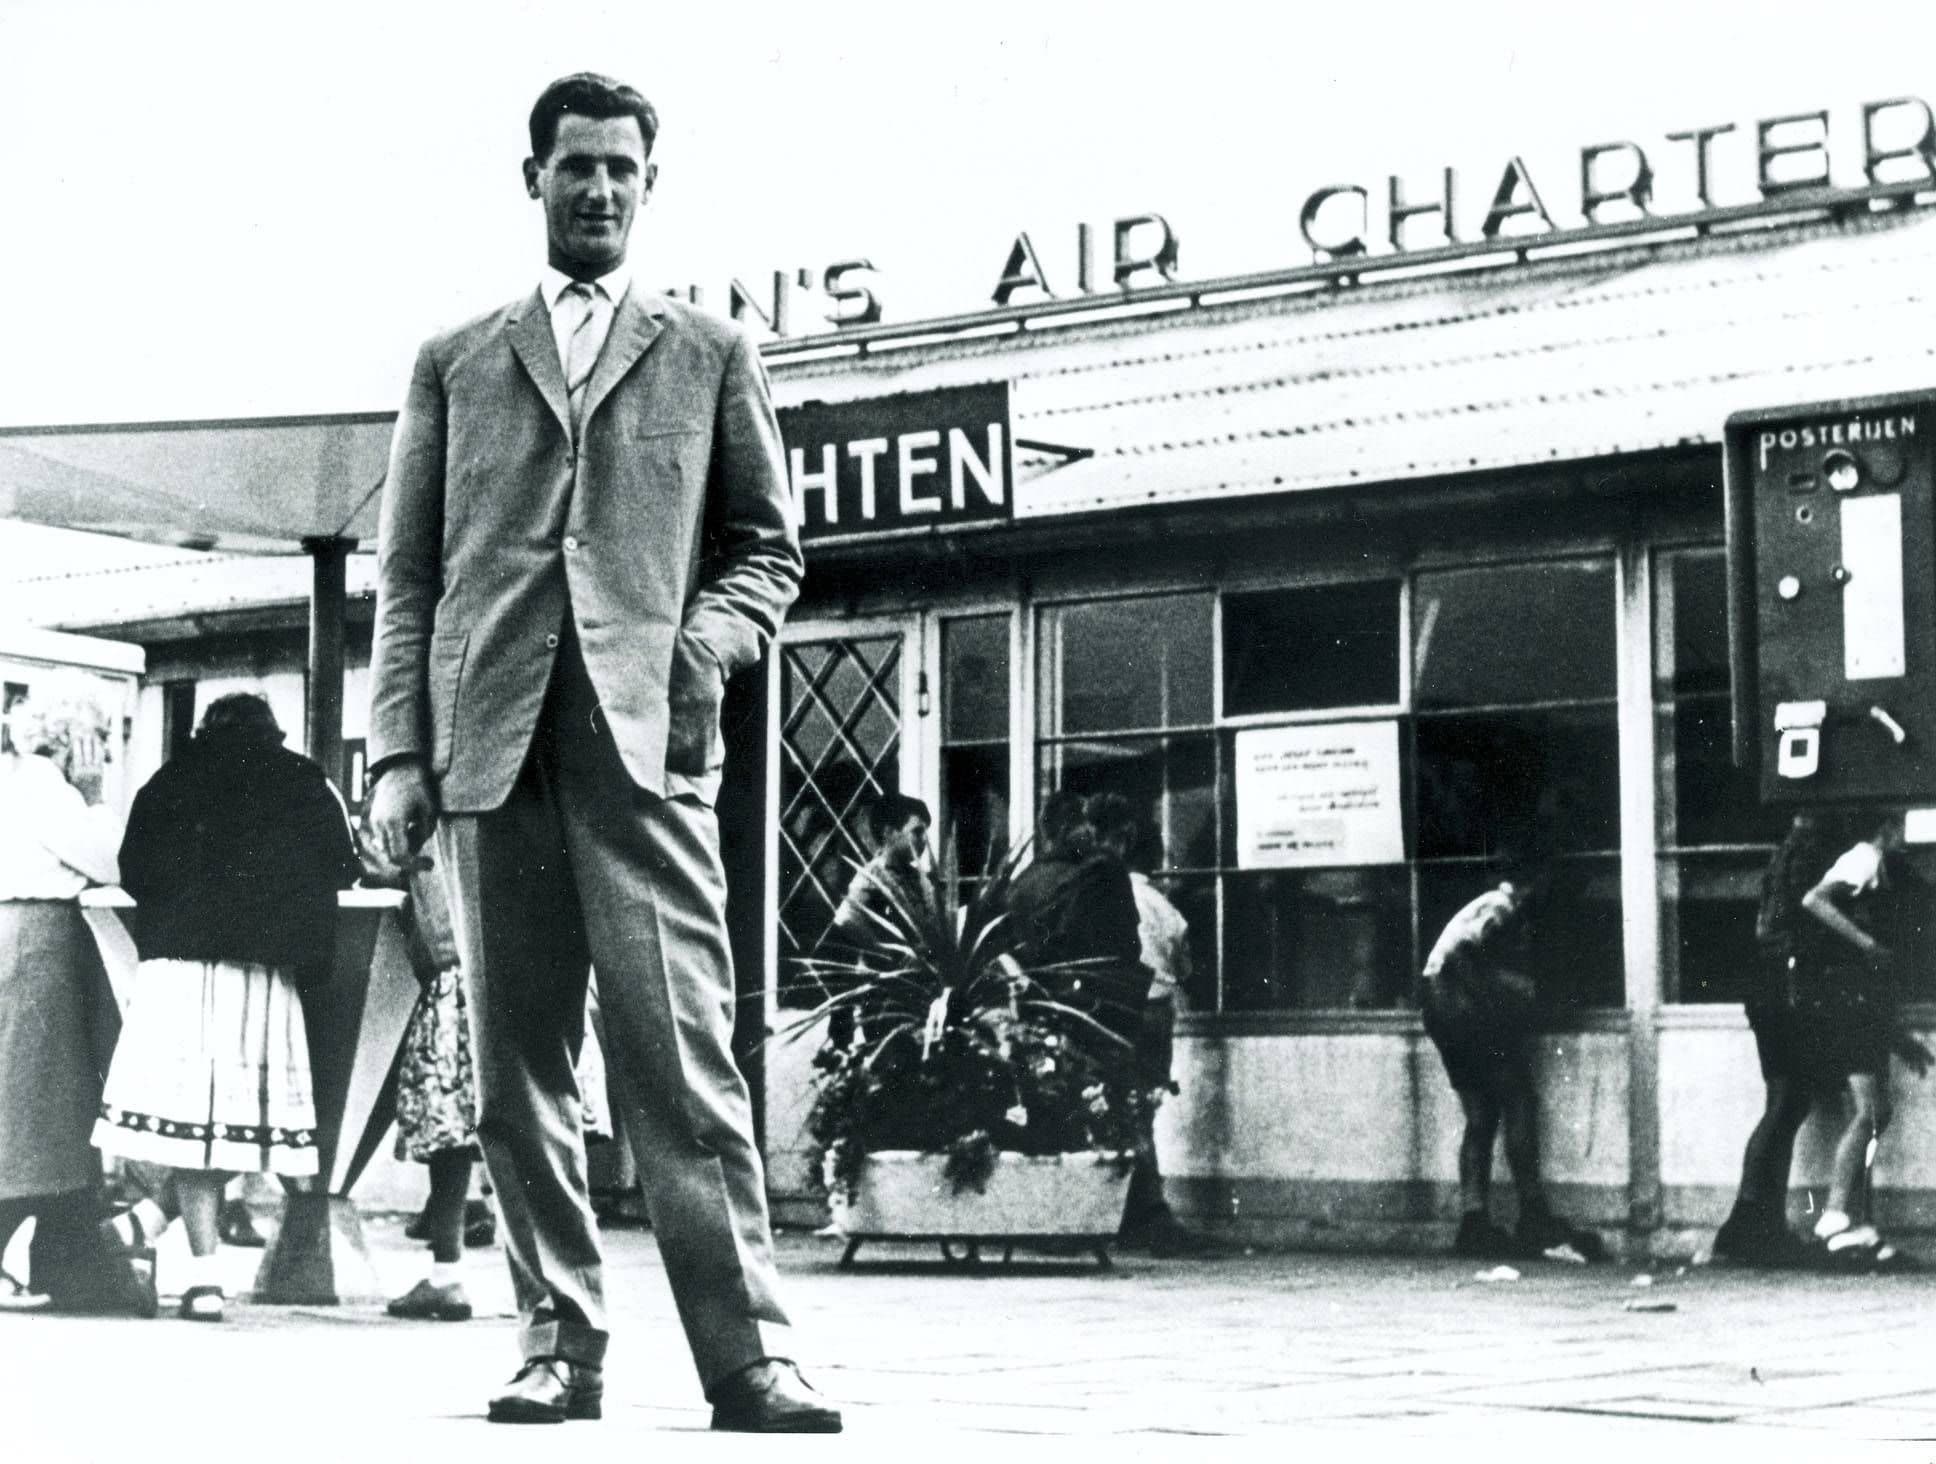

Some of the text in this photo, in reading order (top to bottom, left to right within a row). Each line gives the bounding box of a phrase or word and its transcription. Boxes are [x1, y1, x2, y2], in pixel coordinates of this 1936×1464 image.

[991, 213, 1179, 306] AIR
[1300, 96, 1936, 256] CHARTER
[790, 421, 1005, 528] HTEN
[1760, 415, 1916, 472] POSTERIJEN
